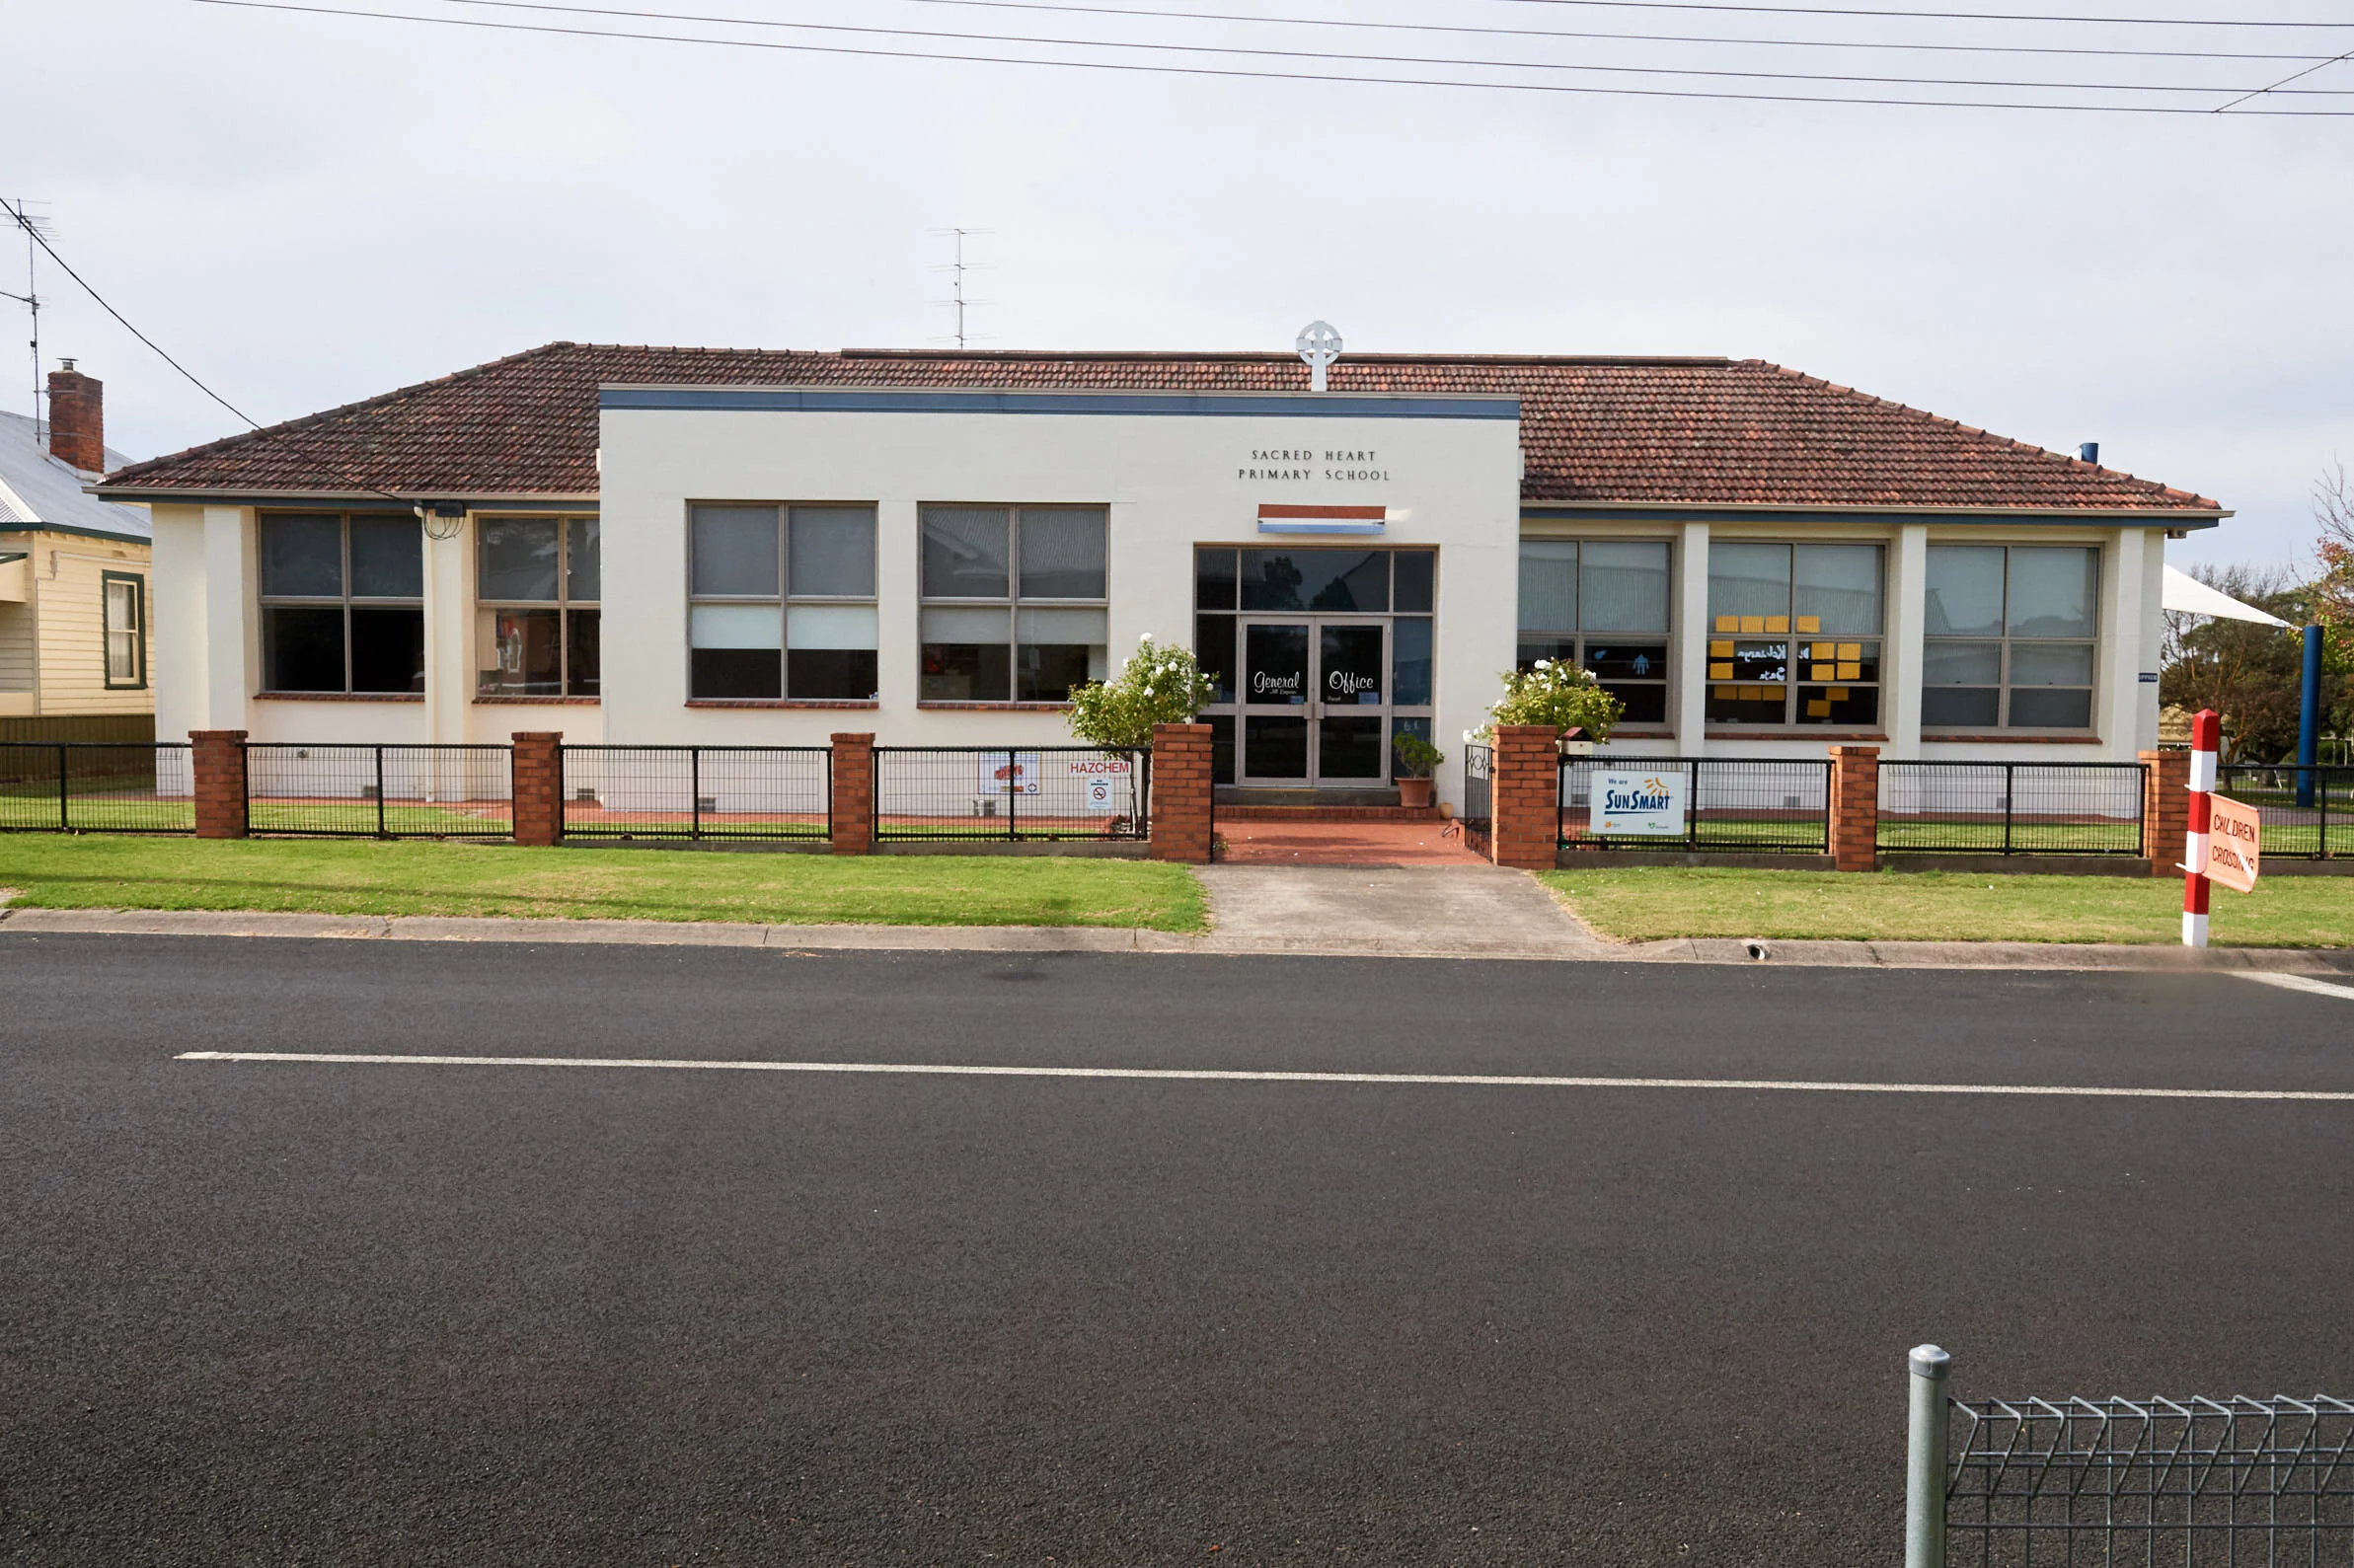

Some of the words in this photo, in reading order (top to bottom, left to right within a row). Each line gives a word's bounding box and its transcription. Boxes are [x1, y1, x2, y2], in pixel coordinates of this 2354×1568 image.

[1252, 450, 1312, 461] SACRED
[1326, 450, 1375, 461] HEART
[1239, 469, 1311, 480] PRIMARY
[1326, 470, 1390, 481] SCHOOL
[1253, 671, 1299, 694] General
[1329, 671, 1373, 694] Office
[1070, 762, 1129, 773] HAZCHEM
[2214, 814, 2255, 843] CHILDREN
